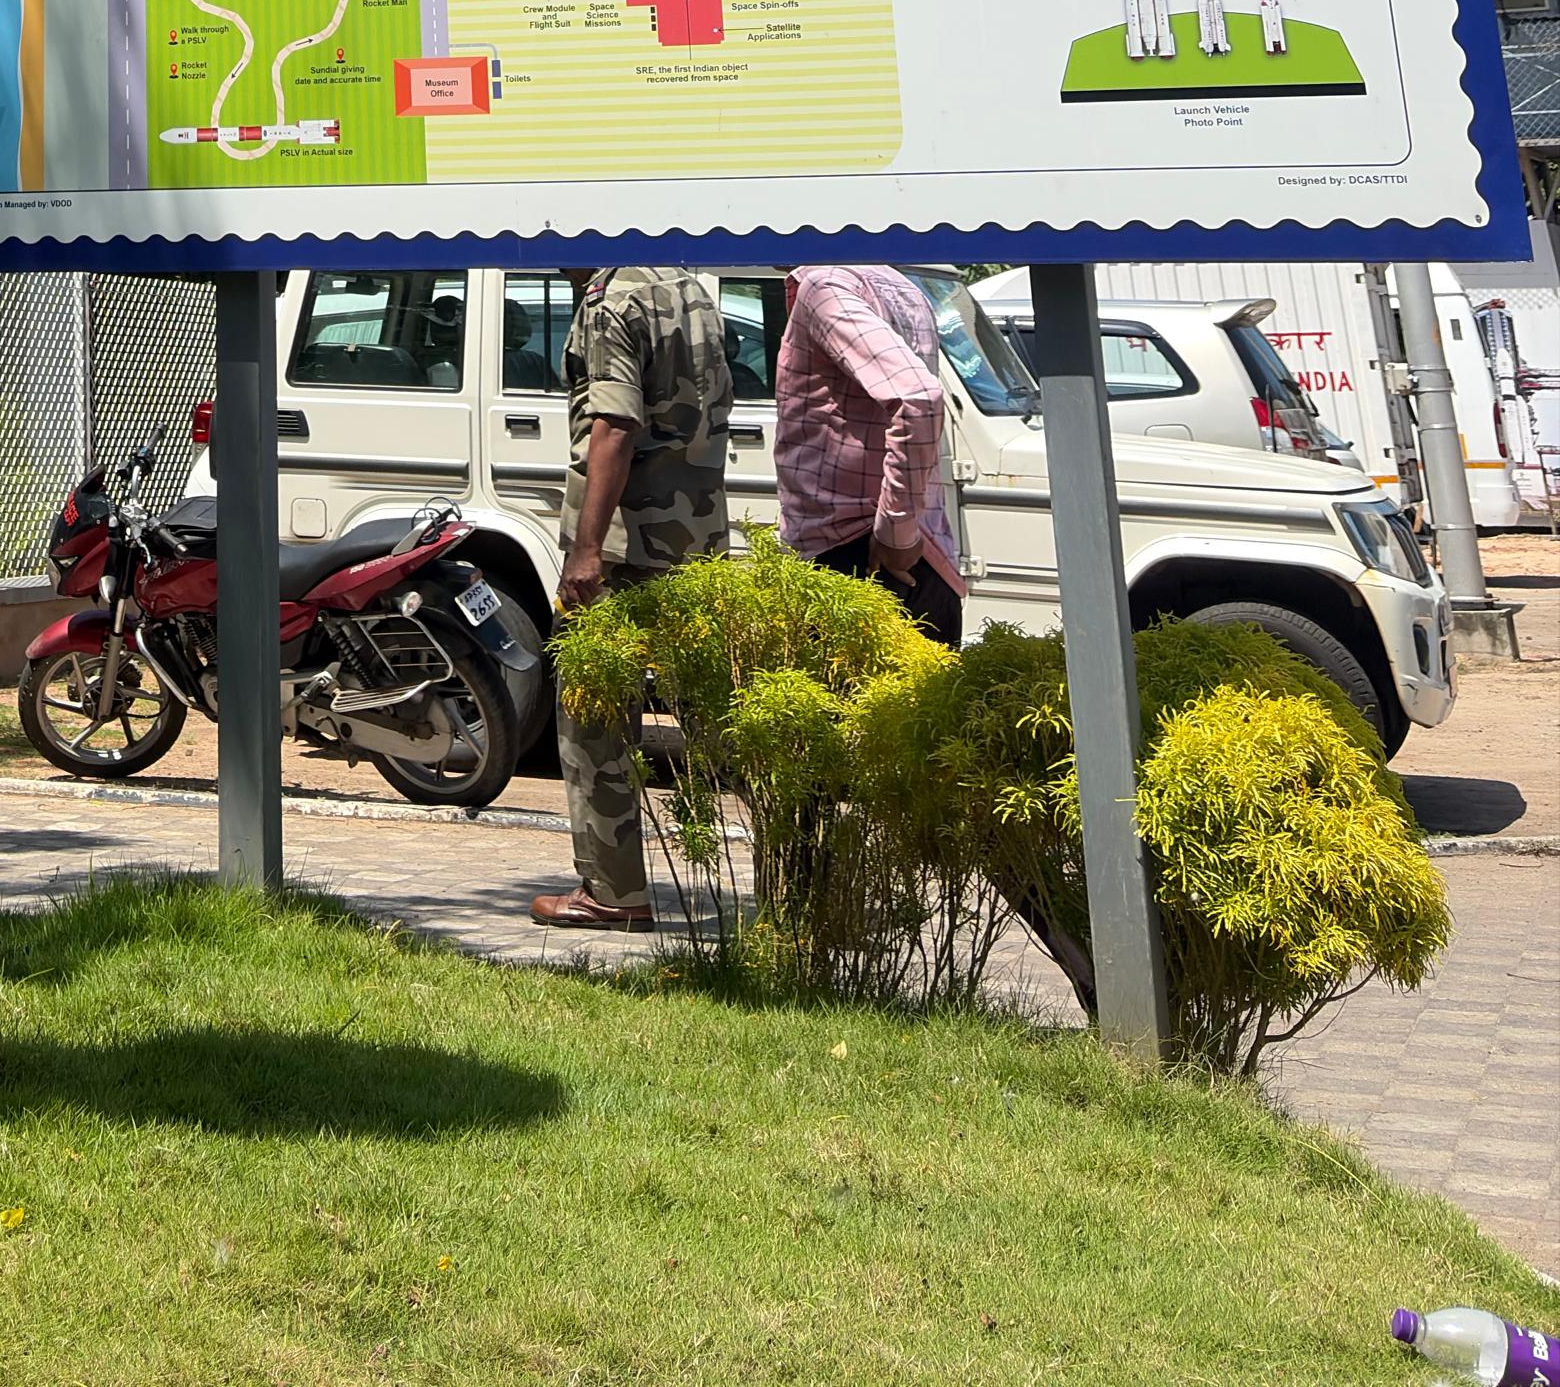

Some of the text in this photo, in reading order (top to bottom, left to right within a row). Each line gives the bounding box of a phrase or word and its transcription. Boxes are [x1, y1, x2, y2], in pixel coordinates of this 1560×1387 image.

[523, 4, 576, 14] Crew Module
[589, 3, 615, 13] Space
[731, 1, 799, 12] Space Spin-offs
[542, 12, 558, 21] and
[586, 10, 619, 20] Science
[529, 19, 571, 31] Flight Suit
[584, 19, 622, 28] Missions
[766, 23, 801, 33] Satellite
[181, 24, 230, 36] Walk through
[187, 35, 207, 45] PSLV
[747, 31, 802, 41] Applications
[181, 60, 208, 70] Rocket
[635, 63, 749, 76] SRE, the first Indian object
[310, 65, 365, 76] Sundial giving
[181, 71, 207, 81] Nozzle
[295, 74, 382, 86] date and accurate time
[504, 74, 531, 84] Toilets
[646, 73, 739, 84] recovered from space
[425, 78, 459, 88] Museum
[430, 88, 454, 98] Office
[1174, 104, 1251, 116] Launch Vehicle
[1184, 117, 1244, 128] Photo Point
[280, 147, 353, 157] PSLV in Actual size
[1278, 174, 1409, 187] Designed by: DCAS/TTDI
[4, 200, 36, 211] Managed
[37, 200, 49, 210] by:
[50, 199, 72, 208] VDOD
